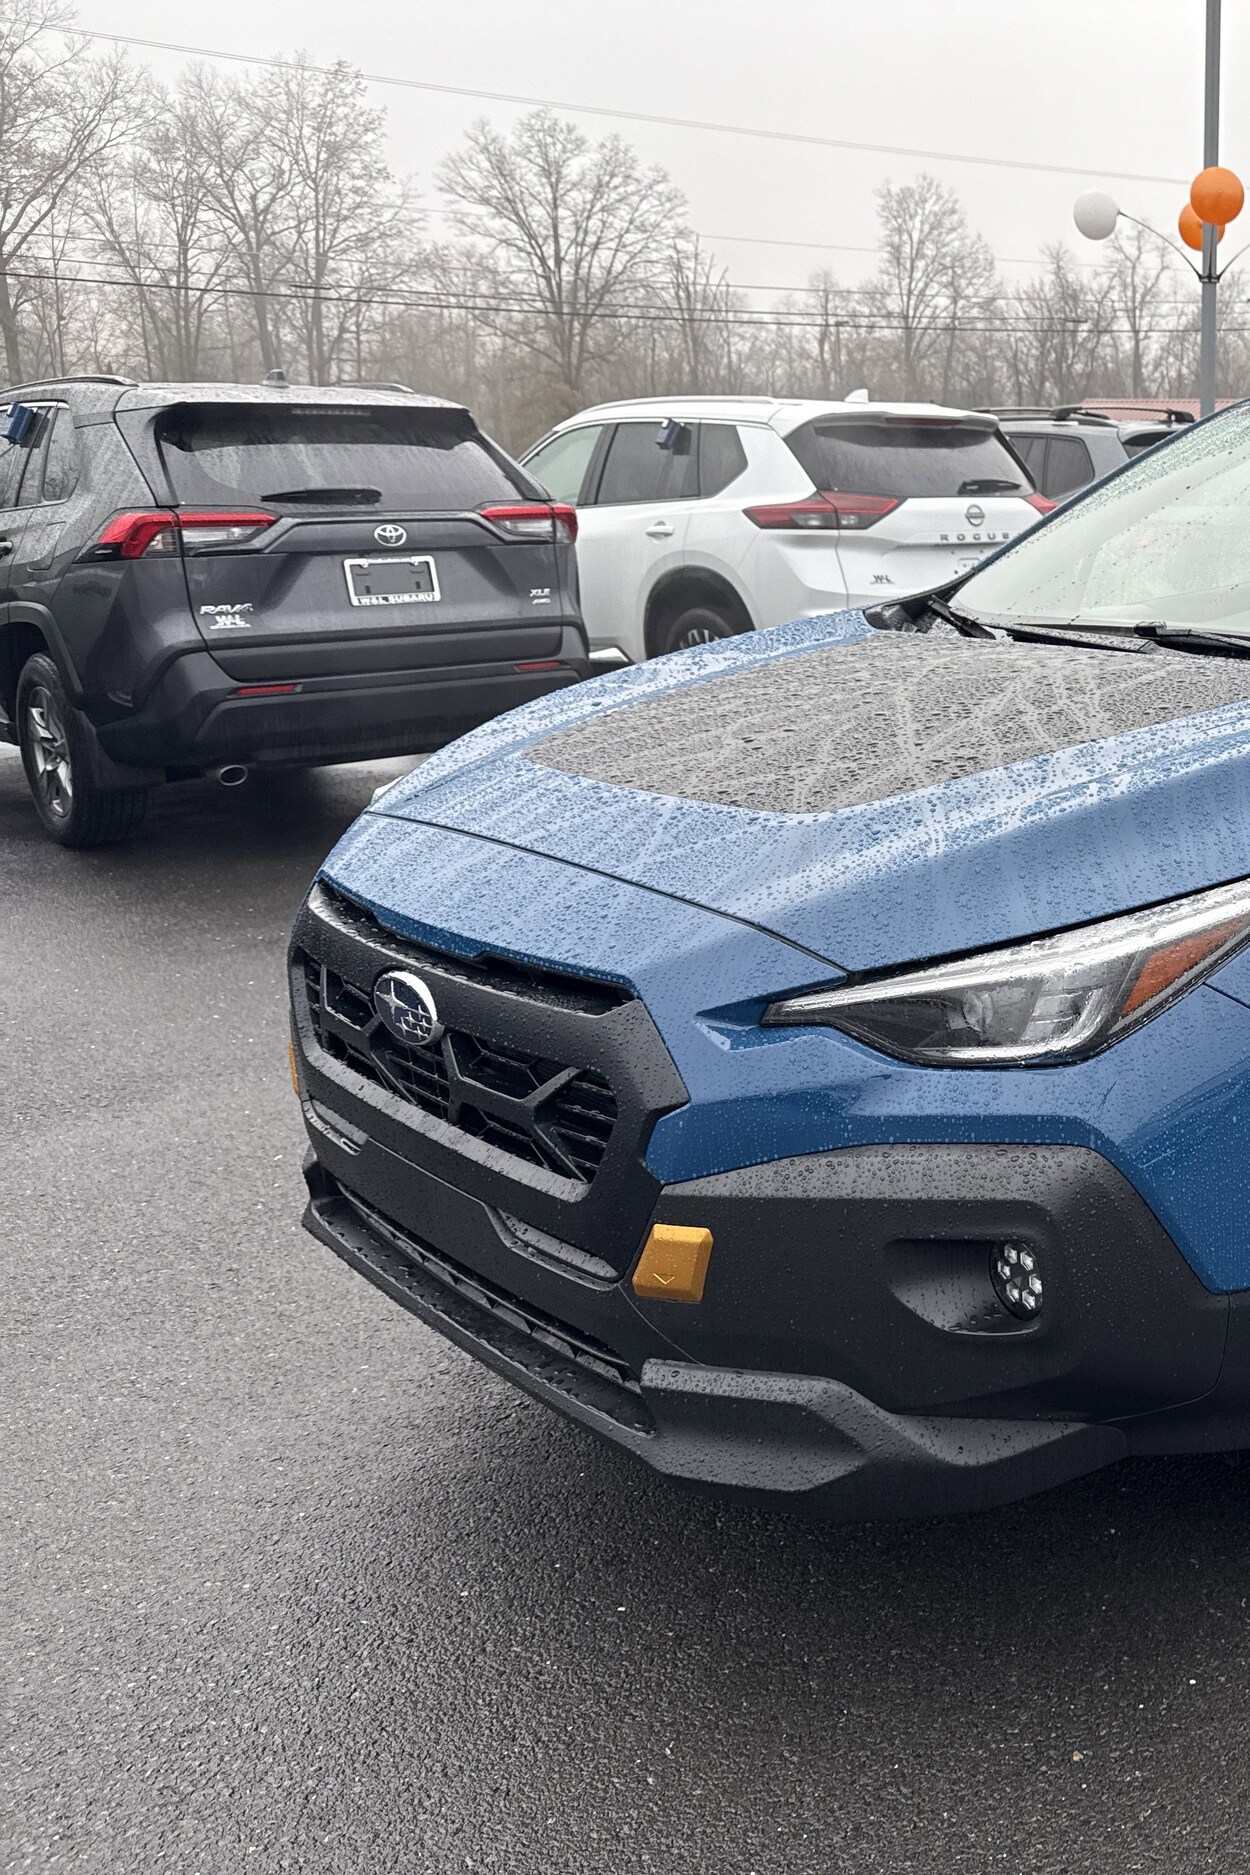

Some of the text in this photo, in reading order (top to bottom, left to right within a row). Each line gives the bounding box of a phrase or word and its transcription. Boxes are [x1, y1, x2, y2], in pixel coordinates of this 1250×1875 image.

[939, 532, 1010, 542] ROGUE
[529, 588, 551, 597] XLE
[389, 592, 434, 604] SUBARU
